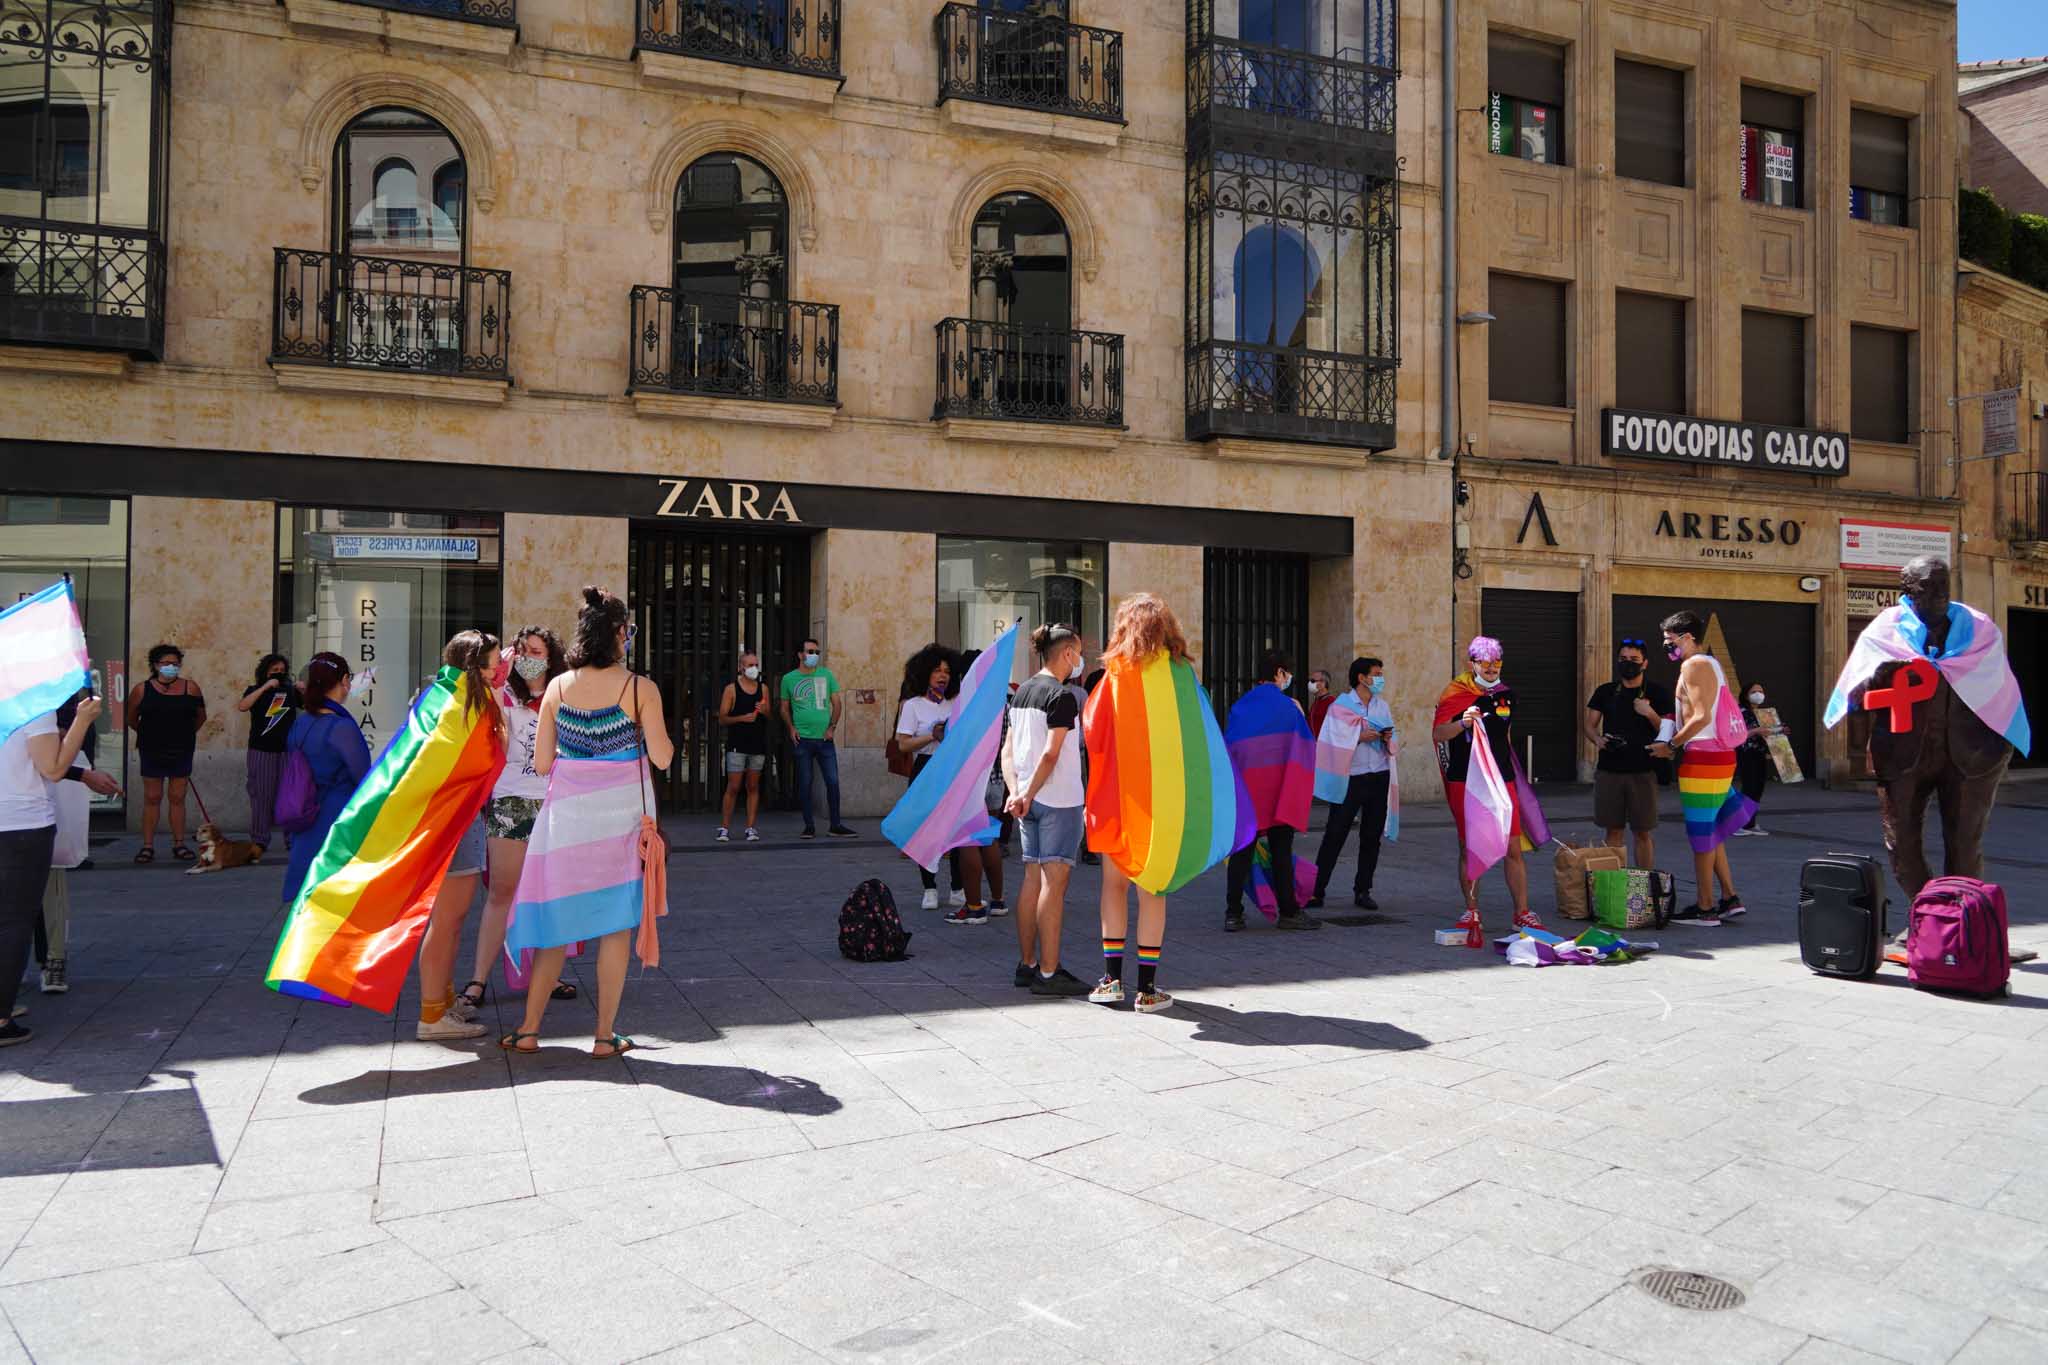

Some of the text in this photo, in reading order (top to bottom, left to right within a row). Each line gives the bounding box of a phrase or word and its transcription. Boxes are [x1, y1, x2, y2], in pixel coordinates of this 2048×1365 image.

[1612, 415, 1845, 470] FOTOCOPIAS CALCO
[656, 479, 803, 522] ZARA
[1655, 510, 1801, 546] ARESSO
[1700, 547, 1754, 560] JOYERÍAS
[360, 599, 377, 750] REBAJAS
